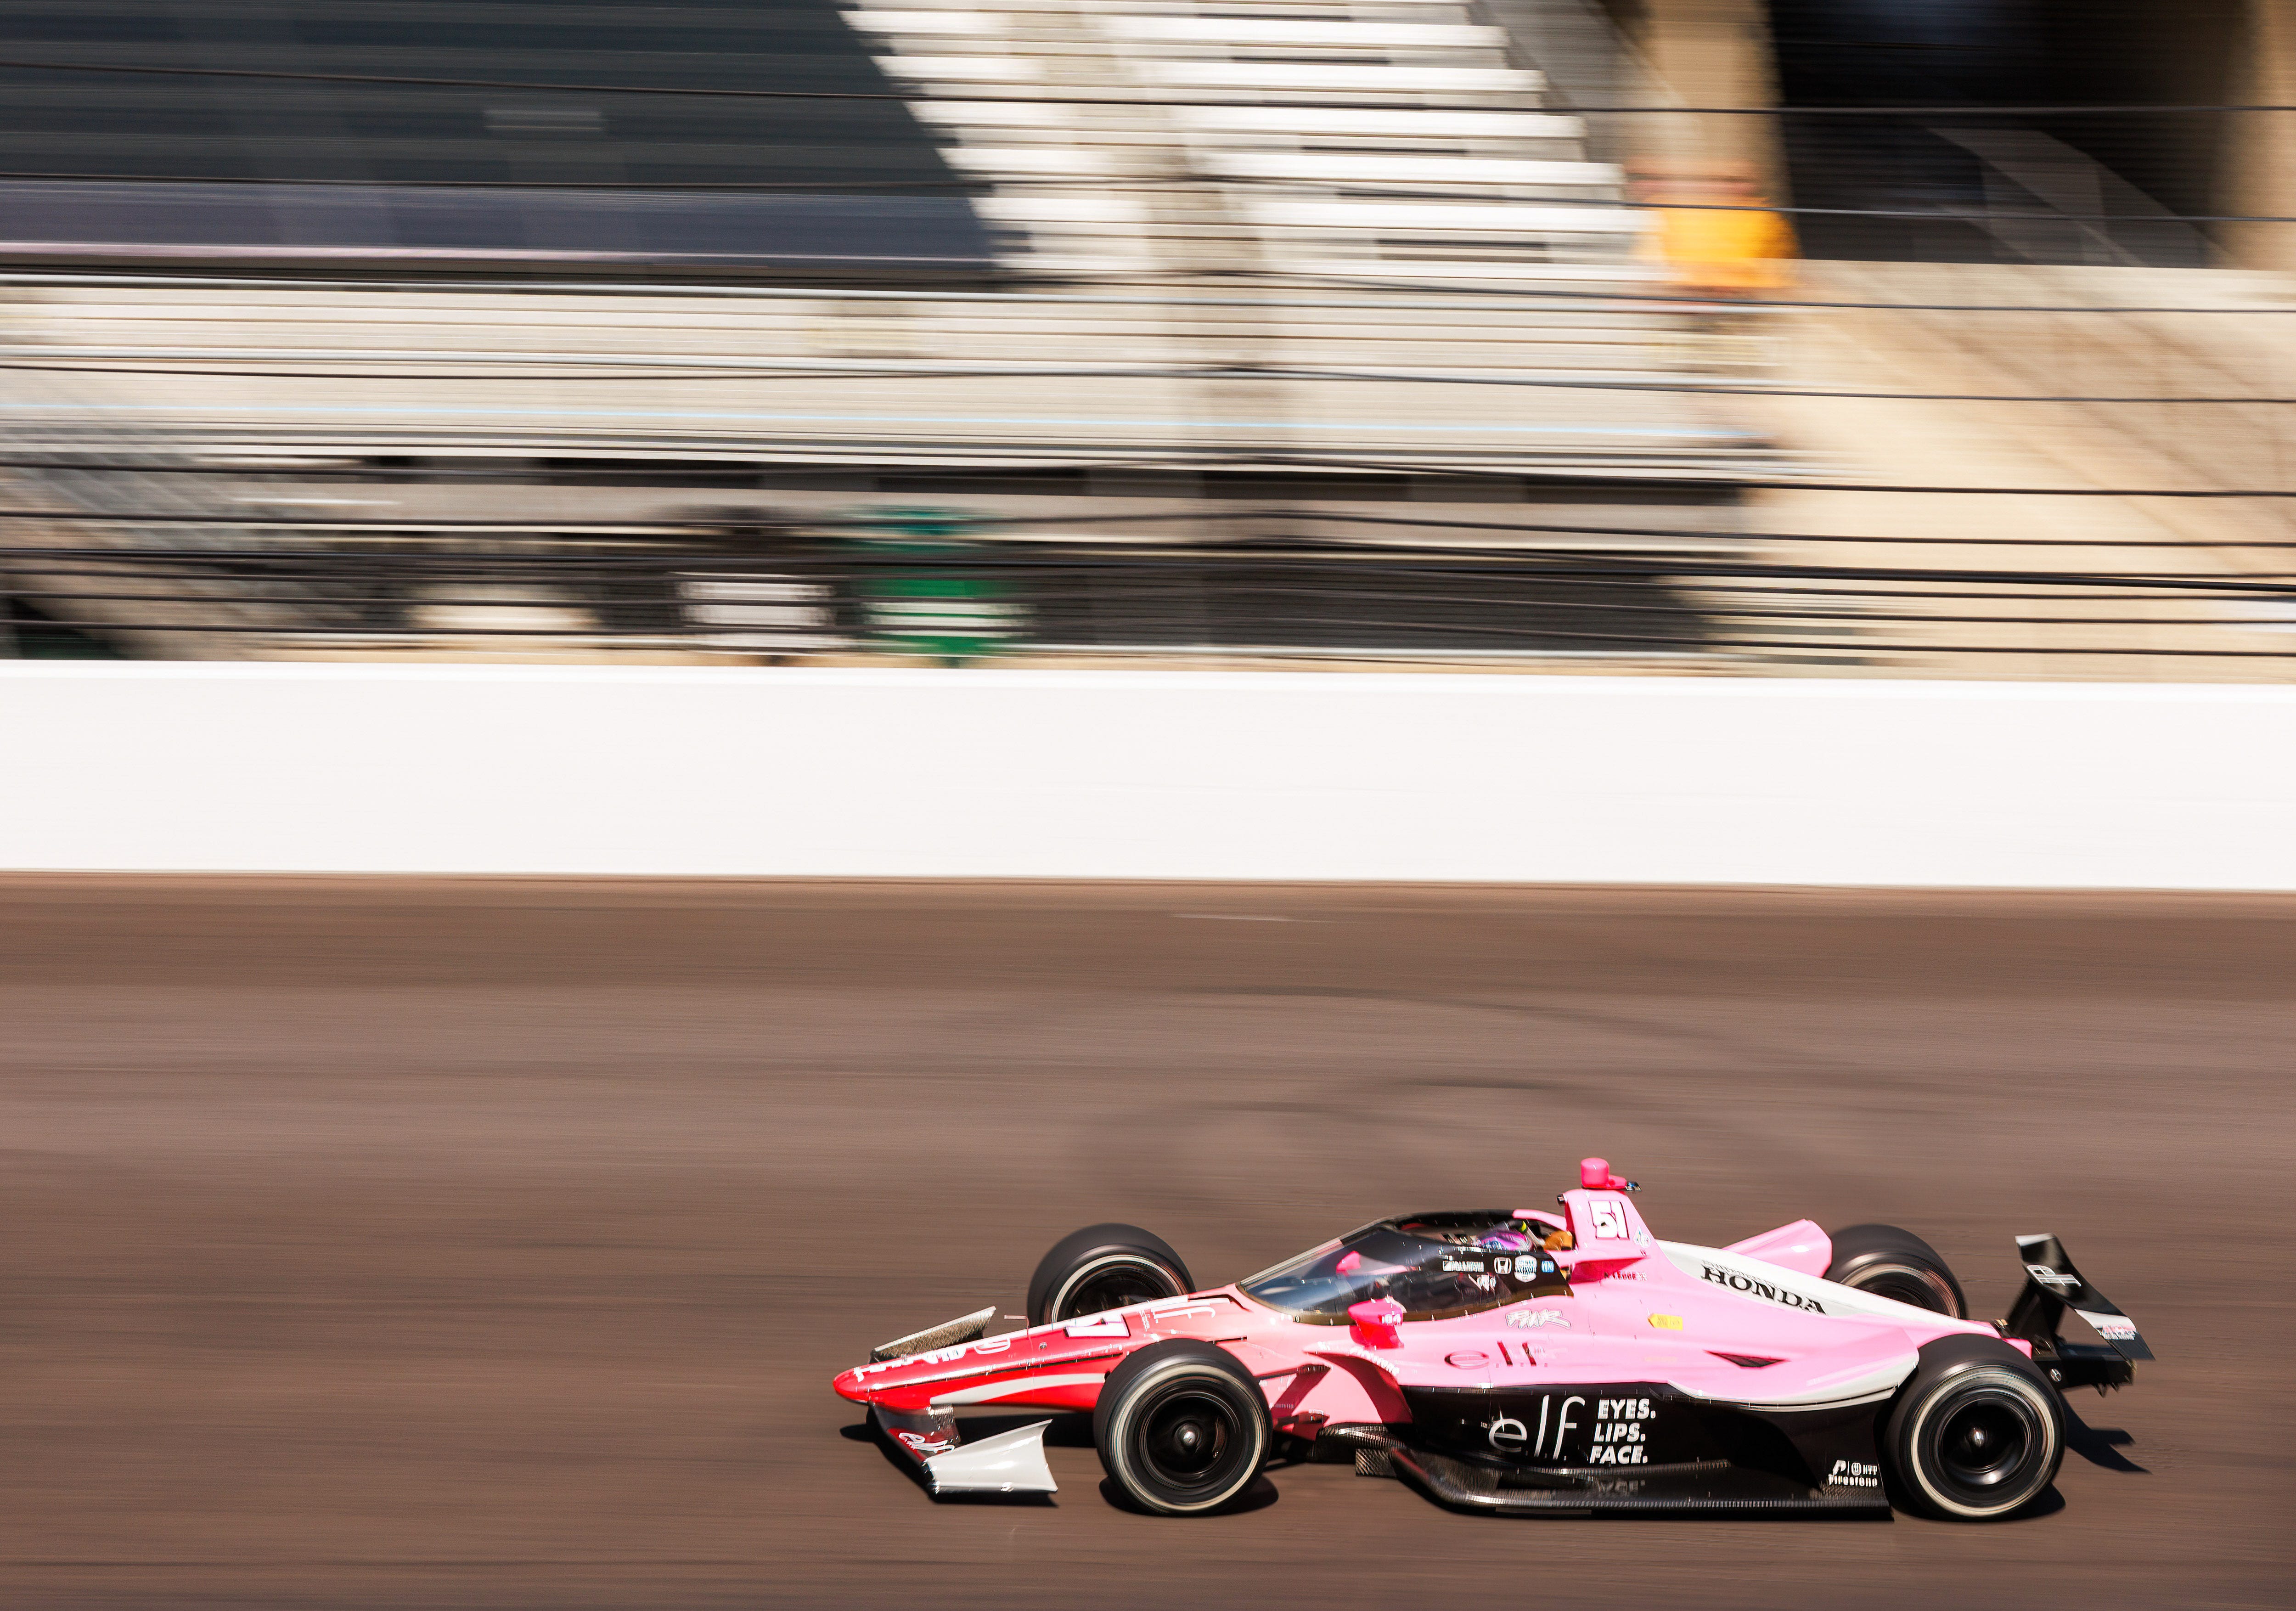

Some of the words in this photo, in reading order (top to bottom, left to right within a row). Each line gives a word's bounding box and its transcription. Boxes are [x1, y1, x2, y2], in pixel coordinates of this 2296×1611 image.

[1588, 1200, 1629, 1239] 51
[1700, 1264, 1829, 1316] HONDA
[1598, 1398, 1656, 1419] EYES.
[1594, 1423, 1646, 1442] LIPS.
[1589, 1445, 1648, 1464] FACE.
